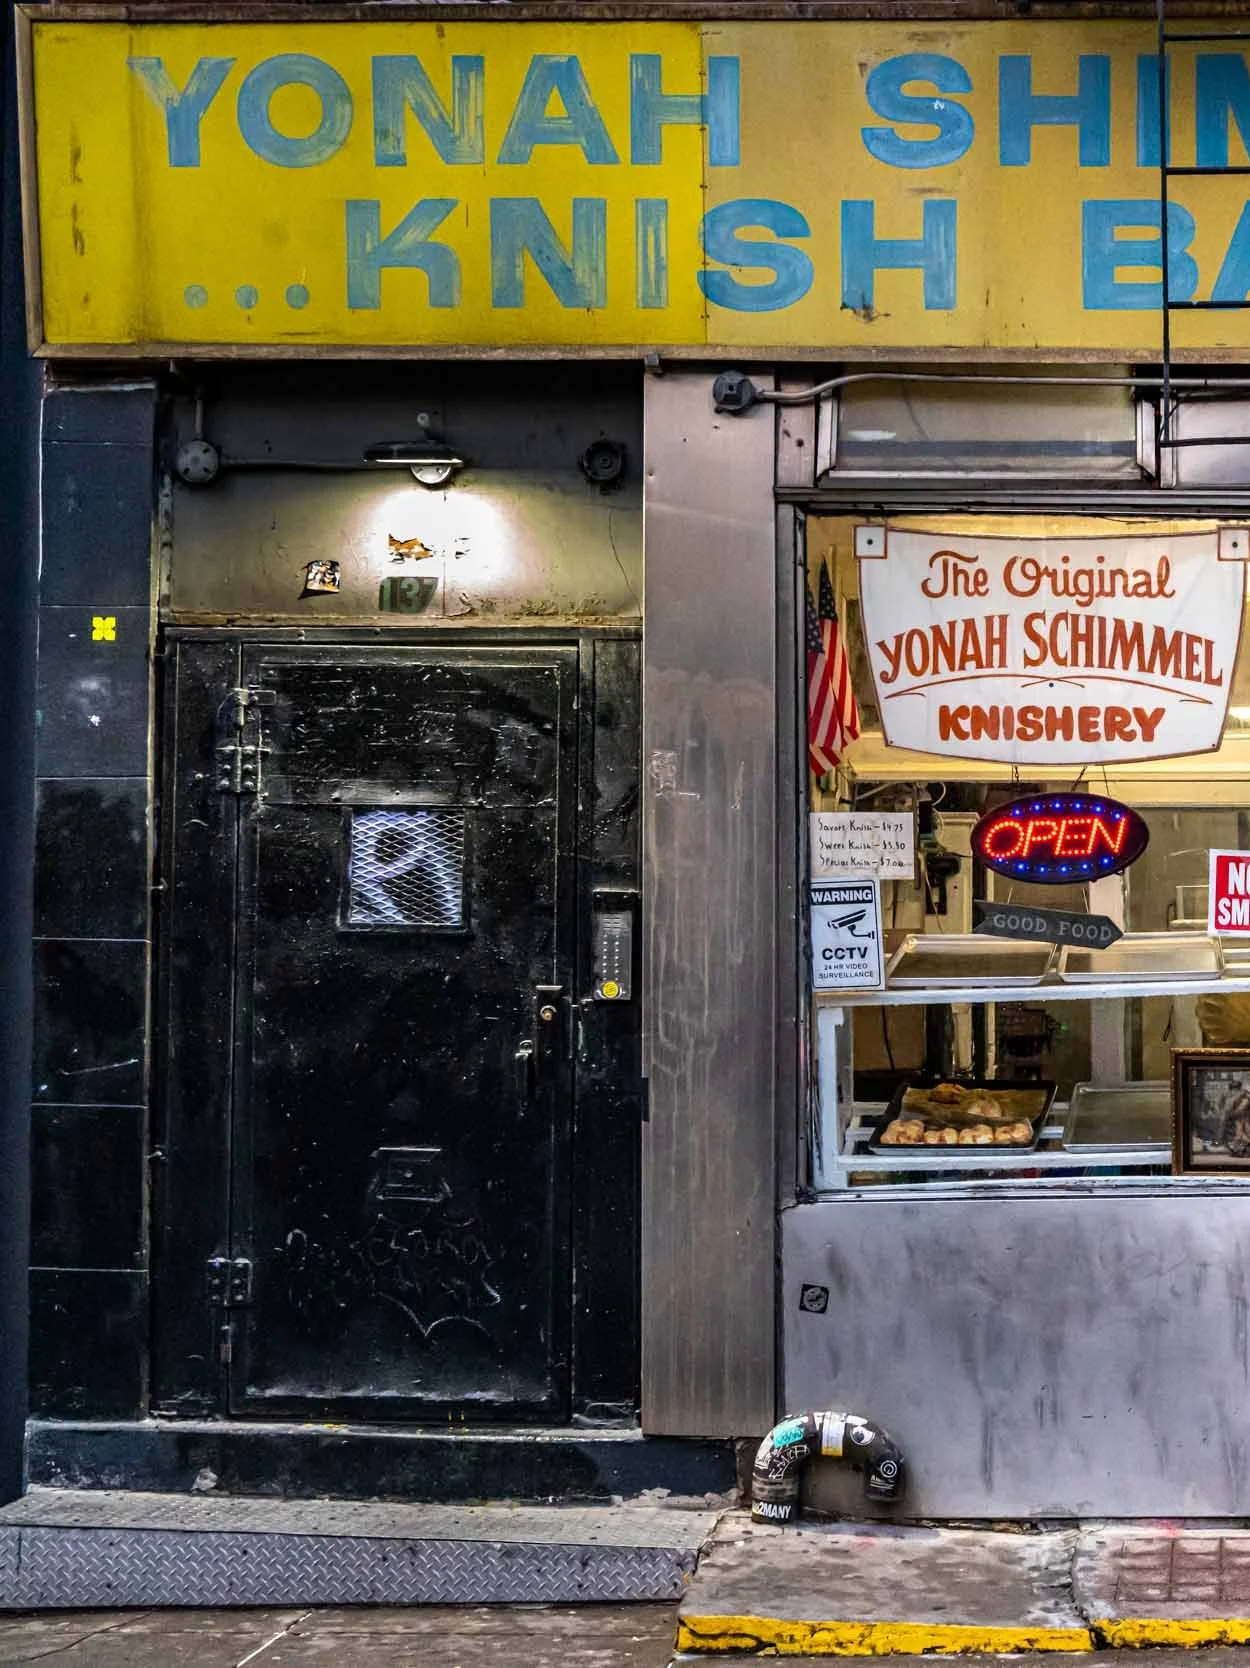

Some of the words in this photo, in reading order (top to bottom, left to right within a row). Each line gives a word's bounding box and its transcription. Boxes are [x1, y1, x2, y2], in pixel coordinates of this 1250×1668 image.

[127, 54, 741, 168] YONAH
[921, 549, 989, 599] The
[1003, 554, 1176, 607] Original
[876, 613, 1010, 684] YONAH
[1022, 609, 1224, 687] SCHIMMEL
[938, 704, 1167, 743] KNISHERY
[983, 816, 1127, 859] OPEN
[811, 889, 872, 903] WARNING
[992, 912, 1048, 934] GOOD
[1058, 921, 1113, 942] FOOD
[822, 946, 868, 961] CCTV
[846, 962, 868, 970] VIDEO
[818, 970, 874, 980] SURVEILLANCE
